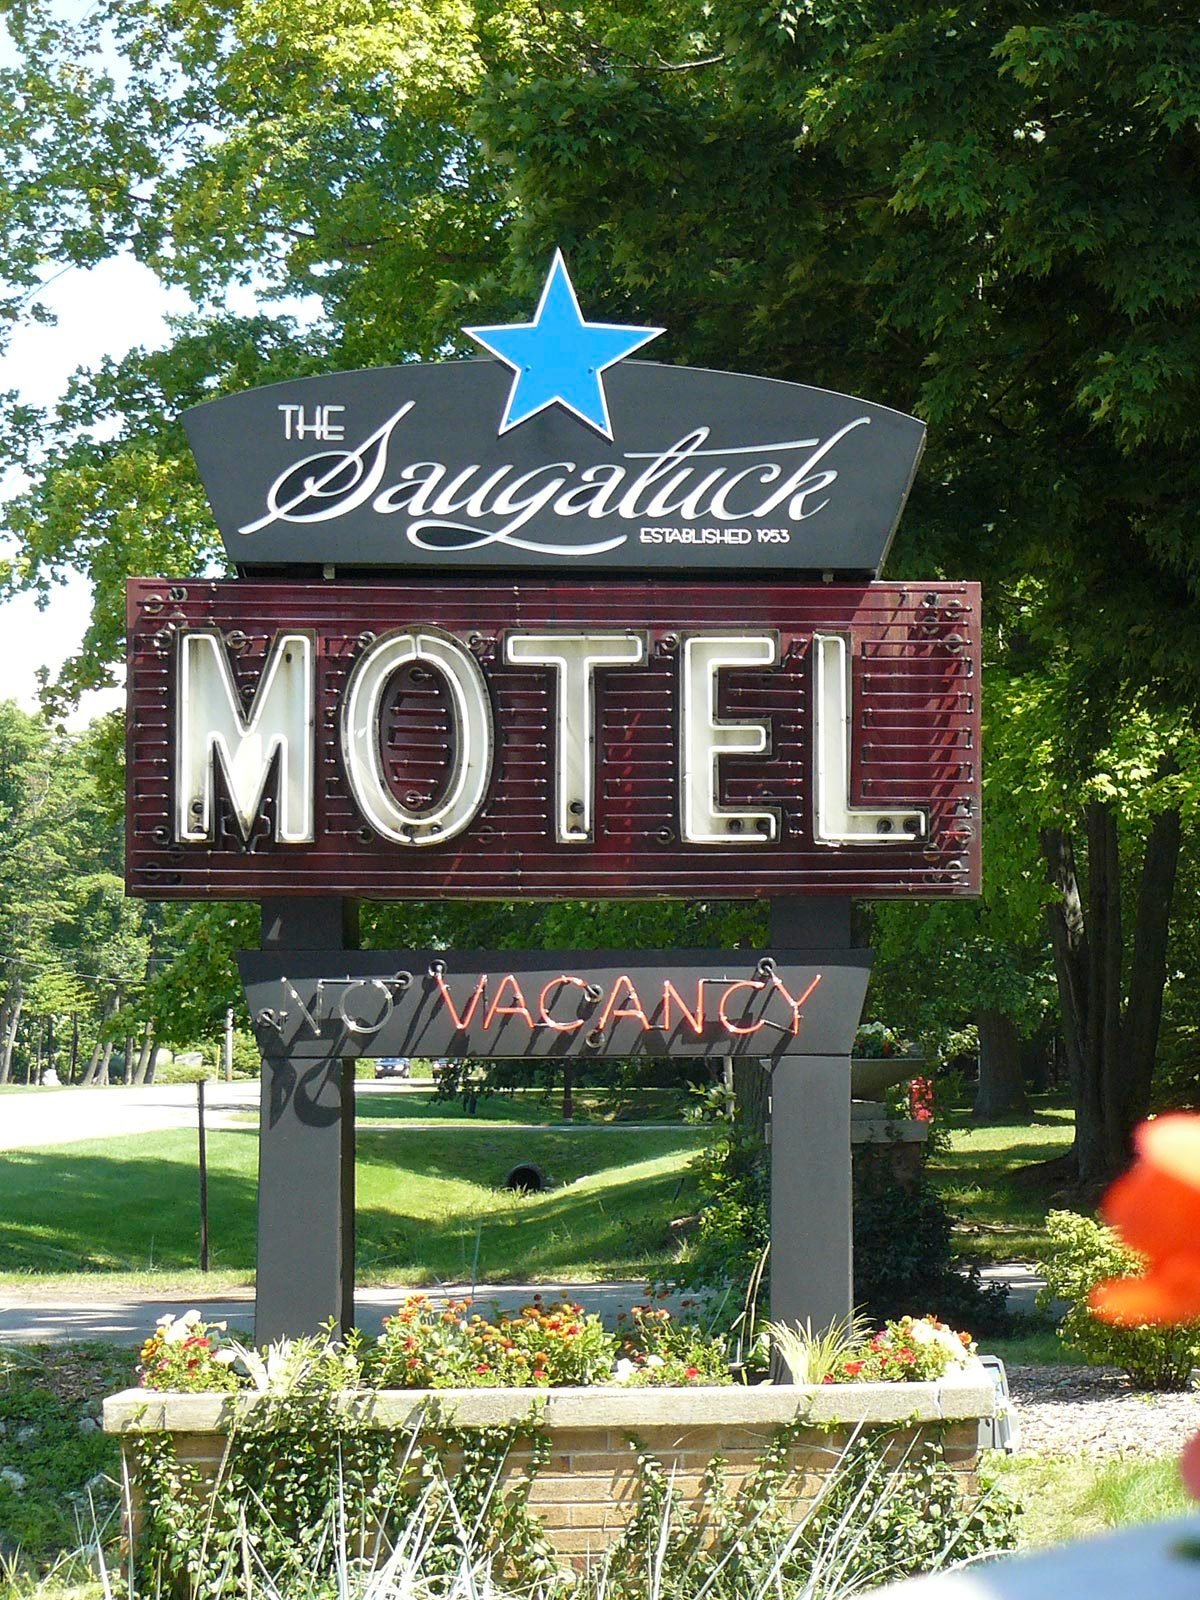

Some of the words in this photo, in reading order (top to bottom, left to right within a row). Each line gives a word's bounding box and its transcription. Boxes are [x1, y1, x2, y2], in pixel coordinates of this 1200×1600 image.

[278, 405, 345, 440] THE
[238, 401, 871, 555] Saugatuck
[640, 527, 752, 544] ESTABLISHED
[756, 529, 790, 543] 1953
[174, 627, 928, 846] MOTEL
[280, 976, 394, 1036] NO
[434, 973, 824, 1035] VACANCY
